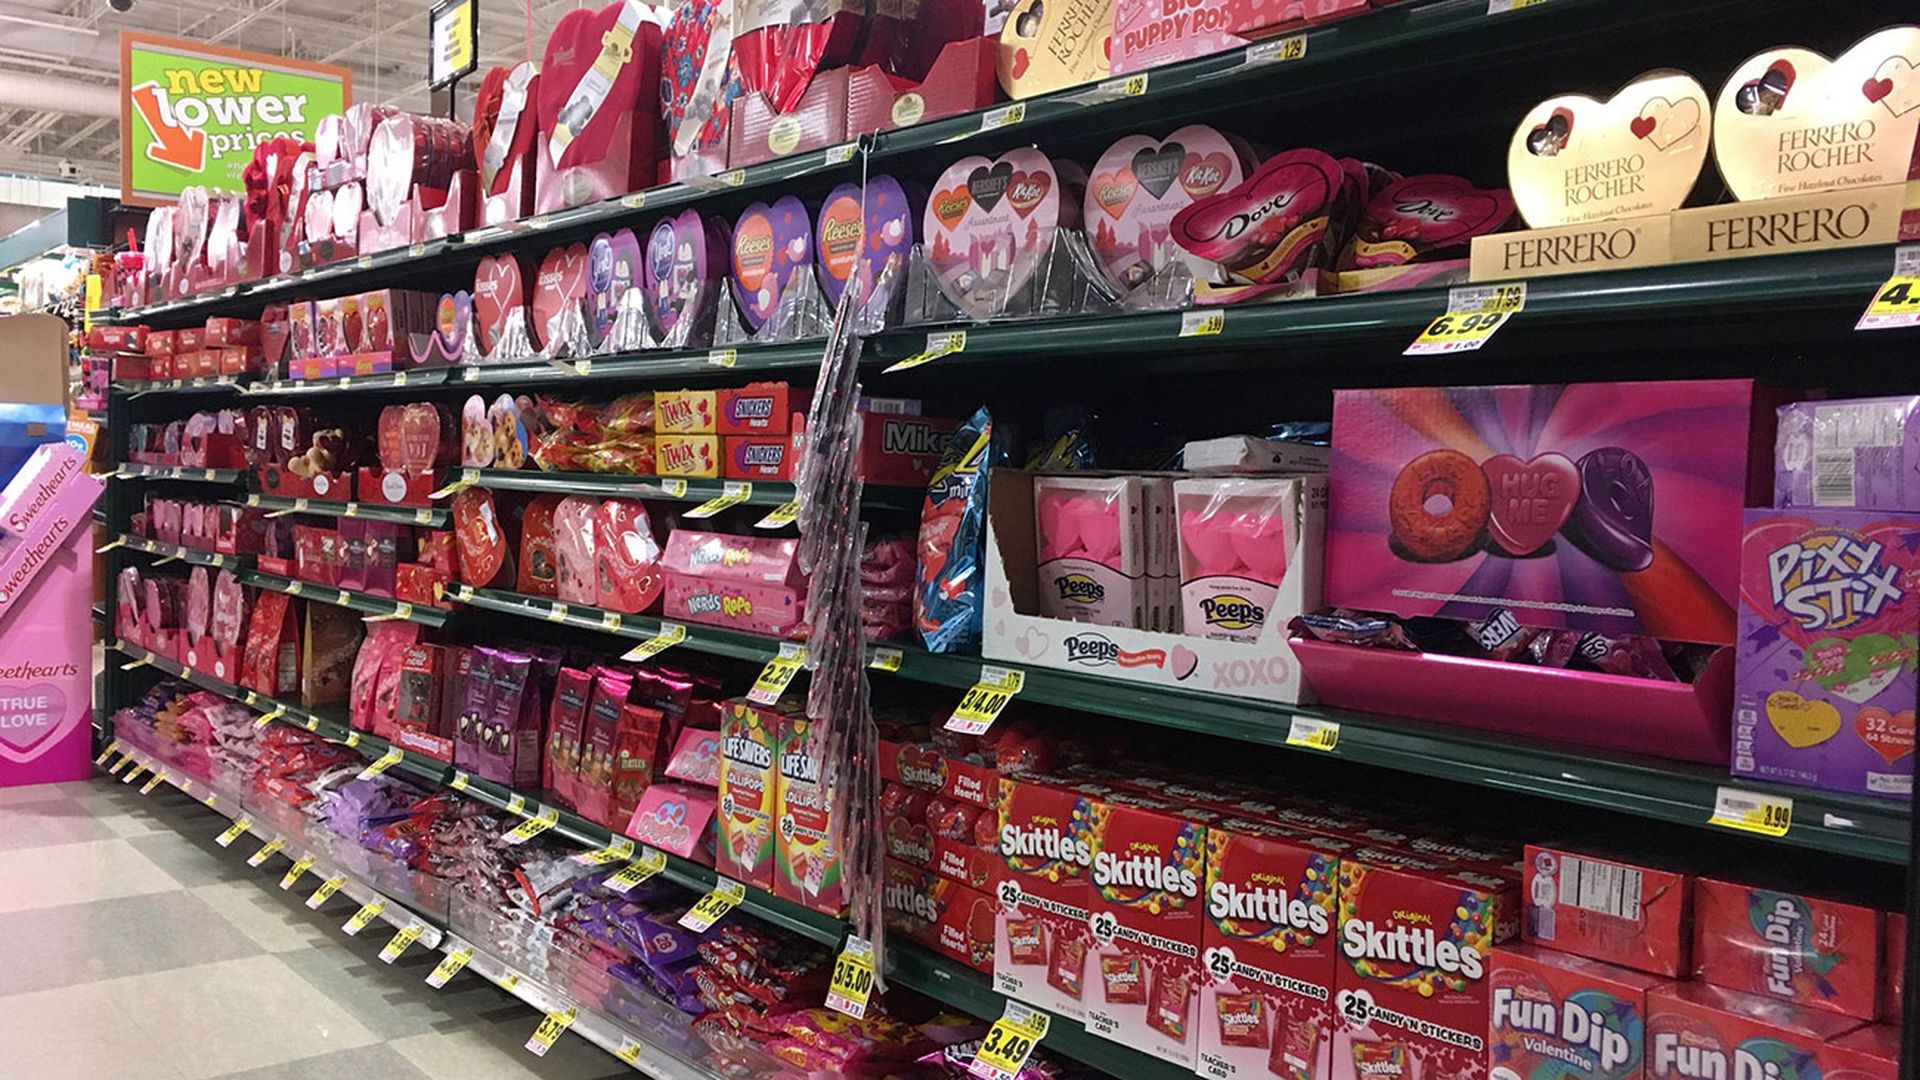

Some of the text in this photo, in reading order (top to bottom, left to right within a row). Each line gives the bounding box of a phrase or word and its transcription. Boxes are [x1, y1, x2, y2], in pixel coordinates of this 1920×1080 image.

[1124, 14, 1187, 54] PUPPY
[165, 68, 263, 95] new
[152, 87, 308, 128] lower
[1779, 120, 1876, 152] FERRERO
[1565, 154, 1645, 187] FERRERO
[1778, 143, 1874, 174] ROCHER
[1565, 175, 1645, 206] ROCHER
[1837, 174, 1883, 185] Chocolates
[1217, 193, 1297, 241] Dove
[1707, 204, 1870, 253] FERRERO
[1503, 228, 1637, 271] FERRERO
[1428, 313, 1504, 336] 6.99
[736, 398, 772, 417] SNICKERS
[745, 446, 783, 464] SNICKERS
[10, 455, 78, 533] Sweethearts
[1502, 472, 1561, 497] HUG
[1509, 498, 1551, 523] ME
[1055, 576, 1105, 599] Peeps
[1199, 594, 1265, 622] Peeps
[1063, 635, 1119, 661] Peeps
[760, 664, 795, 686] 2.29
[1212, 656, 1290, 689] XOXO
[0, 696, 48, 711] TRUE
[960, 689, 1007, 715] 3/4.00
[1, 713, 48, 728] LOVE
[1866, 717, 1887, 731] 32
[1866, 732, 1879, 742] 64
[739, 737, 772, 769] SAVERS
[904, 766, 943, 786] Skittles
[958, 775, 981, 790] Filled
[954, 785, 984, 803] Hearts!
[1764, 805, 1790, 828] 3.99
[894, 839, 931, 861] Skittles
[1001, 822, 1092, 867] Skittles
[940, 860, 968, 880] Hearts!
[944, 851, 965, 867] Filled
[1093, 850, 1198, 898] Skittles
[696, 895, 730, 918] 3.49
[1002, 885, 1017, 904] 25
[1017, 892, 1040, 906] CANDY
[1210, 880, 1330, 936] Skittles
[655, 936, 673, 950] 28
[940, 933, 968, 953] Hearts!
[943, 924, 965, 941] Filled
[1096, 917, 1112, 937] 25
[1113, 924, 1139, 940] CANDY
[1151, 938, 1197, 957] STICKERS
[1343, 918, 1483, 980] Skittles
[1765, 899, 1800, 997] Fun Dip
[834, 960, 871, 995] 3/5.00
[1210, 952, 1230, 974] 25
[1230, 961, 1261, 980] CANDY
[1275, 976, 1327, 1000] STICKERS
[538, 1016, 564, 1040] 3.79
[1089, 1010, 1119, 1029] TEACHER'S
[1344, 994, 1367, 1020] 25
[1368, 1006, 1404, 1027] CANDY
[1421, 1023, 1483, 1051] STICKERS
[1493, 988, 1630, 1068] Fun Dip
[984, 1028, 1030, 1064] 3.49
[1523, 1037, 1593, 1071] Valentine
[1655, 1033, 1731, 1080] Fun
[1201, 1053, 1236, 1074] TEACHER'S
